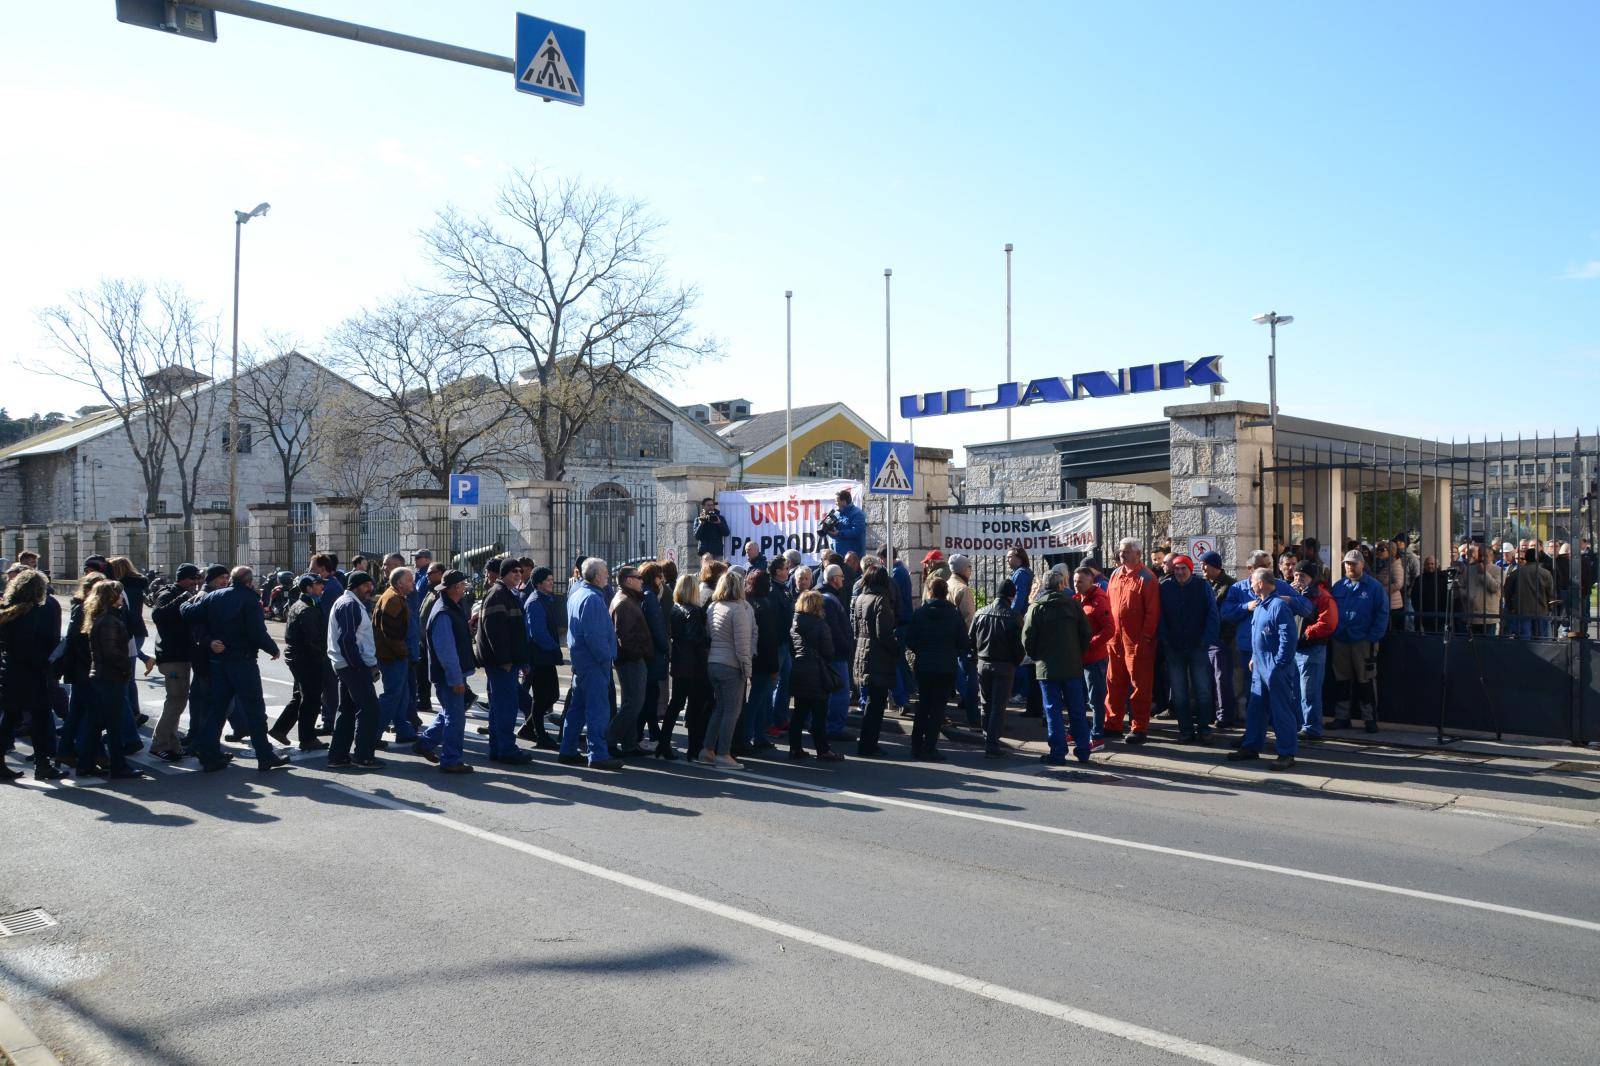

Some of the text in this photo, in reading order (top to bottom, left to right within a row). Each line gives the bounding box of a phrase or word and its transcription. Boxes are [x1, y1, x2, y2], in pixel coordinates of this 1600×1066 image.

[900, 355, 1229, 419] ULJANIK
[459, 480, 471, 499] P
[981, 518, 1052, 534] PODRSKA
[760, 532, 835, 556] PRODA
[944, 530, 1095, 551] BRODOGRADITELJIMA
